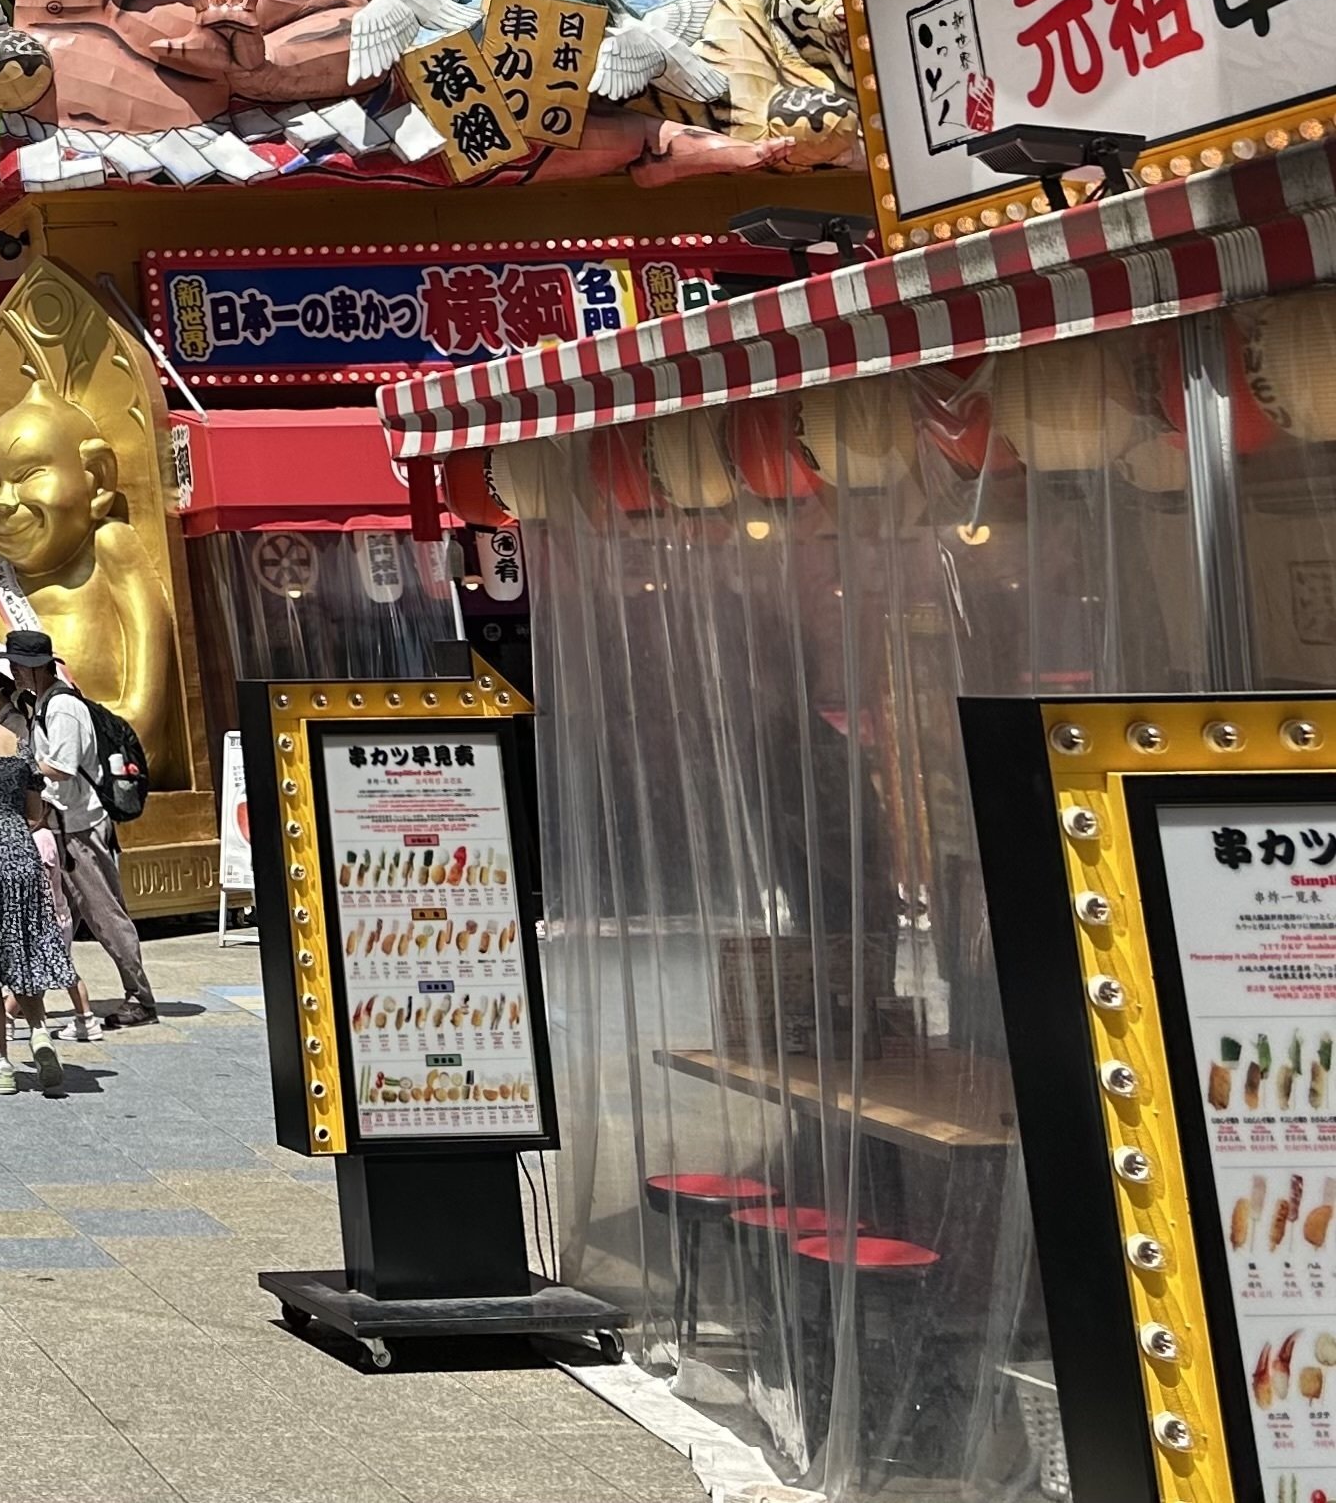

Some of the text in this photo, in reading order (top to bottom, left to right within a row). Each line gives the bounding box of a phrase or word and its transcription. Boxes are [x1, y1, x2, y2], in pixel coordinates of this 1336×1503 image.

[494, 4, 539, 121] 串かつ
[542, 11, 585, 136] 日本一の
[423, 48, 514, 165] 横綱
[175, 279, 208, 357] 新世界
[208, 295, 421, 345] 日本一の串かつ
[424, 266, 576, 353] 横綱
[576, 266, 620, 336] 名門
[494, 557, 519, 584] 肴
[348, 745, 475, 769] 串カツ早見表
